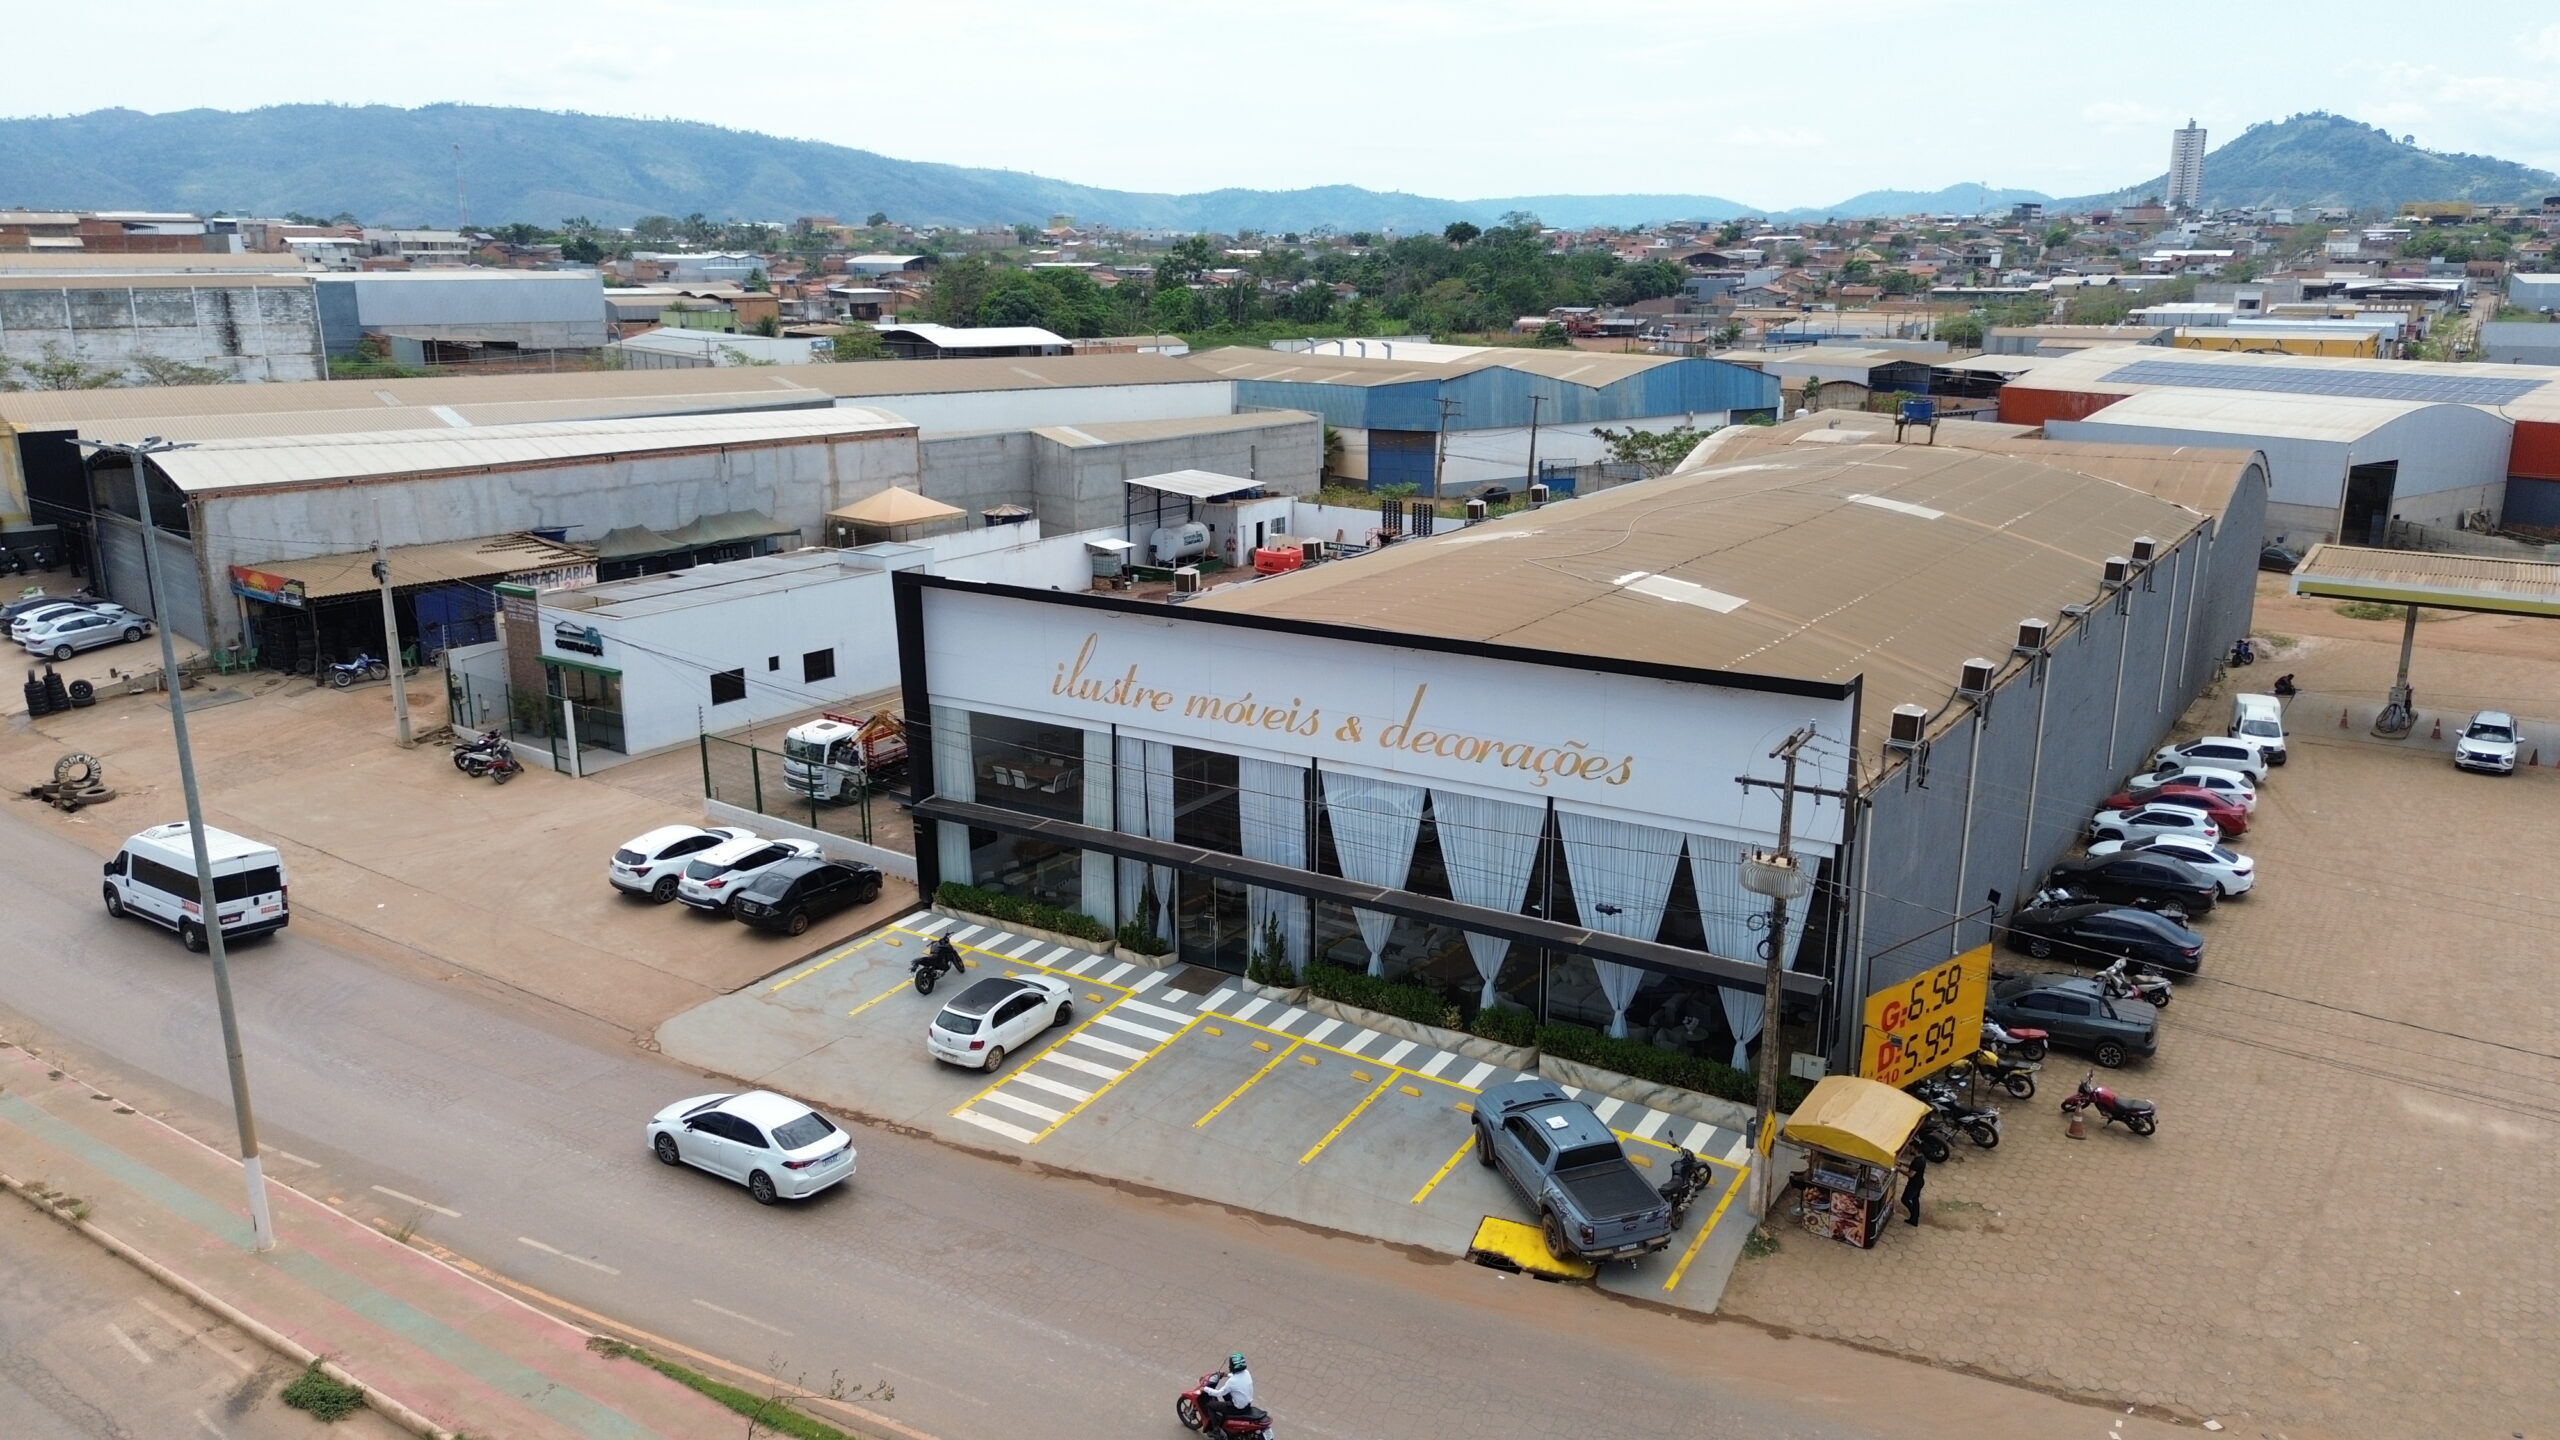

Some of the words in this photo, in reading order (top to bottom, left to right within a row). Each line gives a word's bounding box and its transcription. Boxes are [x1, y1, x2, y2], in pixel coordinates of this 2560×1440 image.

[508, 564, 594, 587] BORRACHARIA
[1051, 632, 1174, 712] ilustre
[1184, 691, 1321, 737] móveis
[1335, 716, 1363, 743] &
[1379, 683, 1635, 787] decorações
